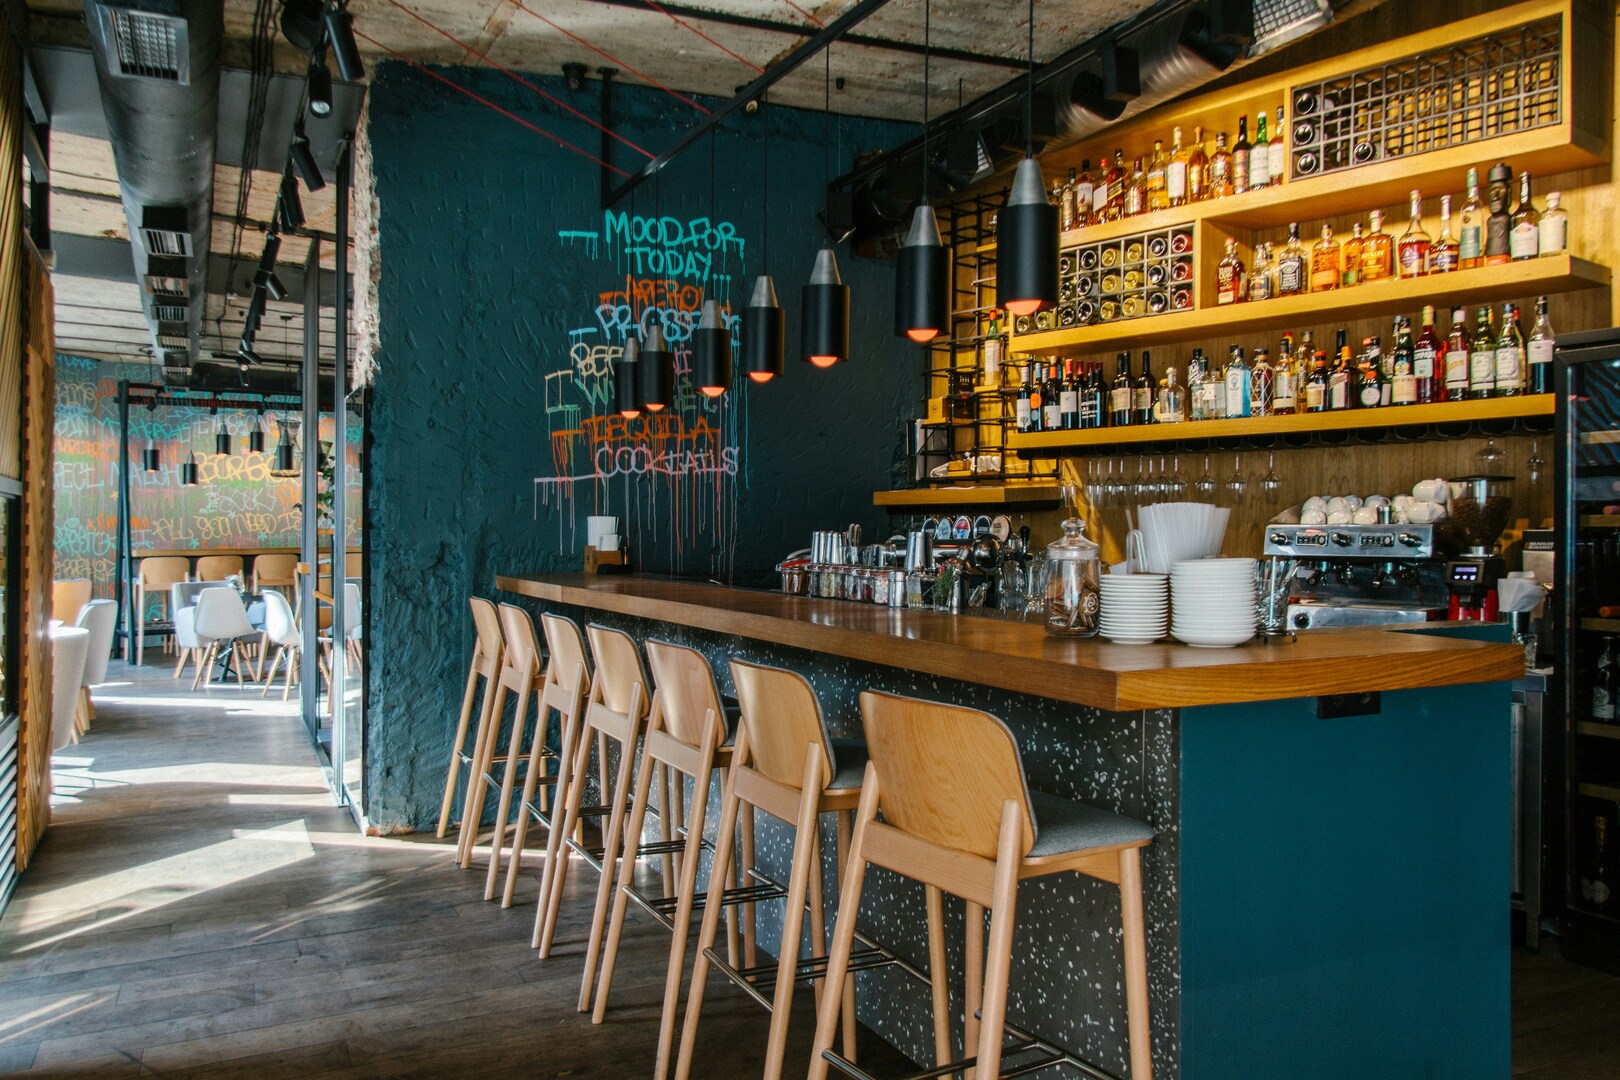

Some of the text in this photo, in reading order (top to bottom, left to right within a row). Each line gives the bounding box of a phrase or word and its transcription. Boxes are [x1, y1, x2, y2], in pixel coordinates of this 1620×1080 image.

[605, 208, 746, 254] MOOD FOR
[624, 246, 733, 282] TODAY...
[580, 408, 722, 443] TEQUILA
